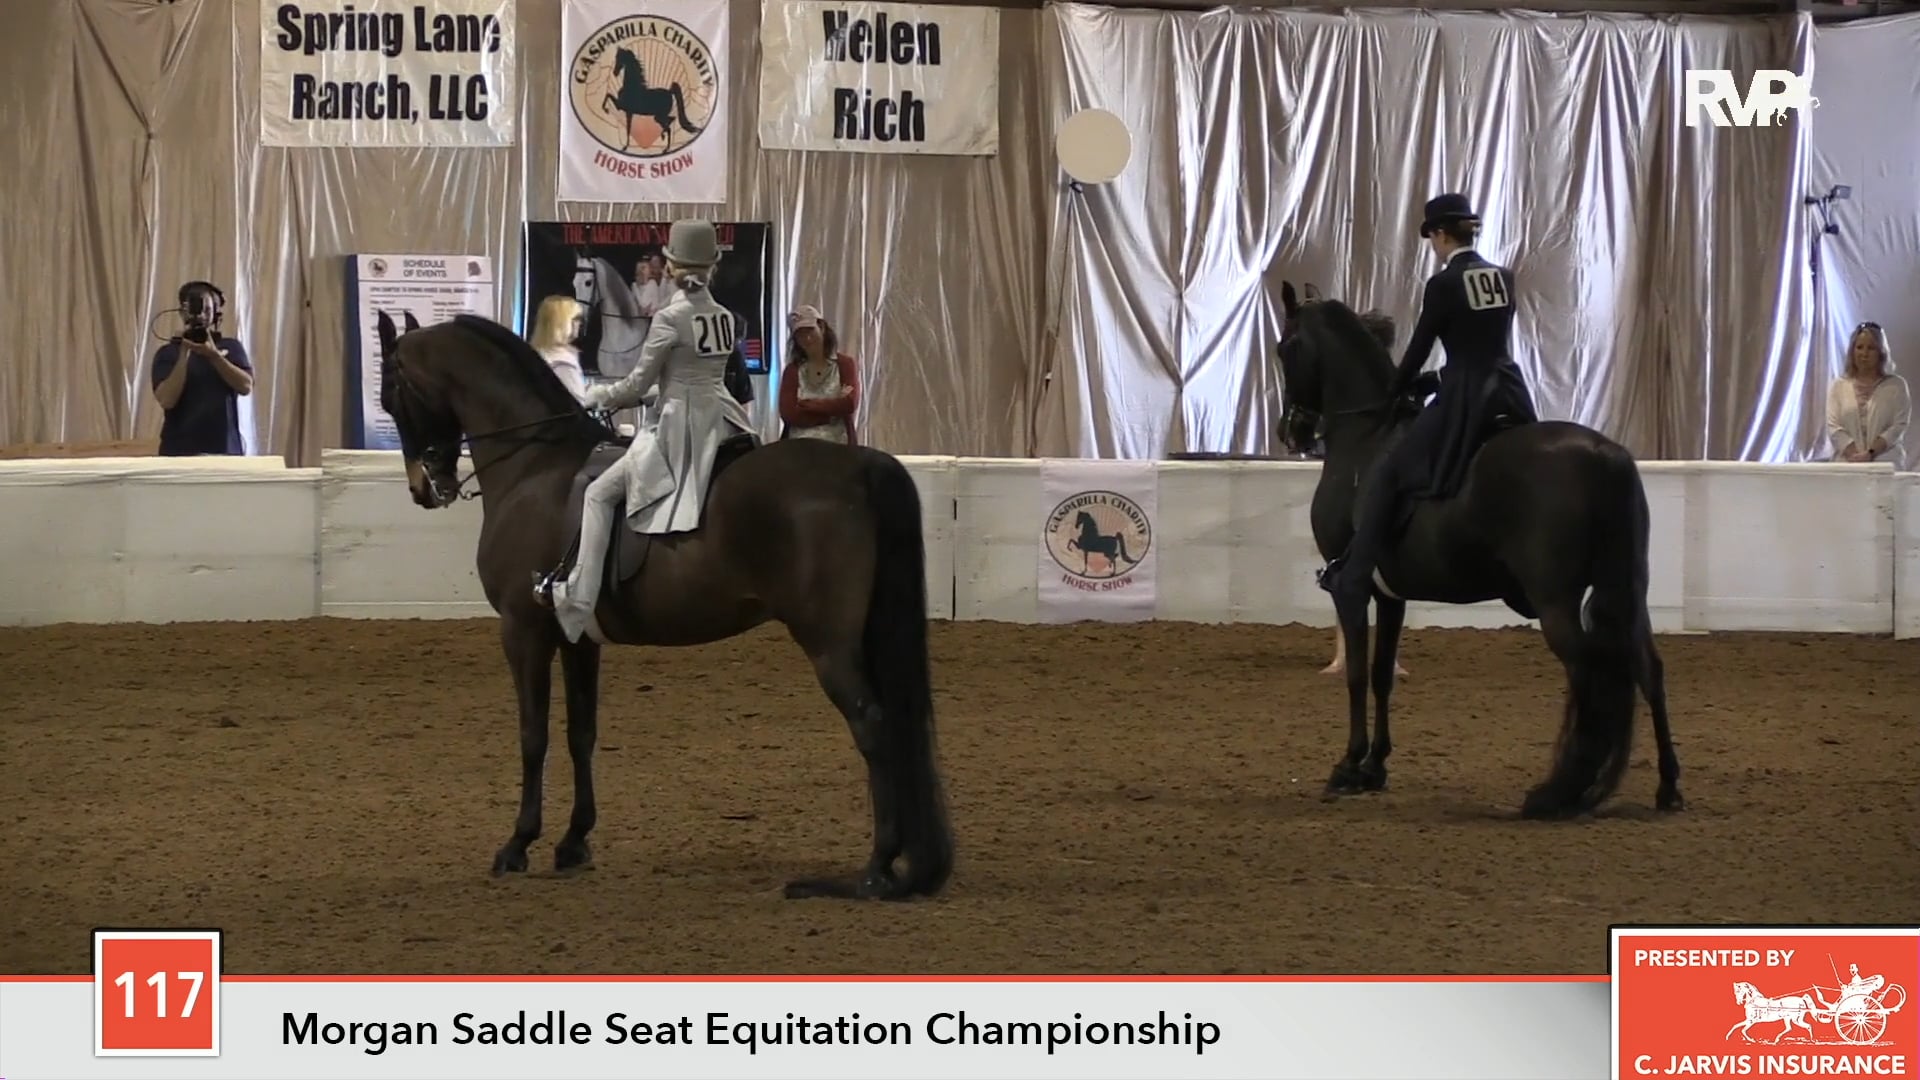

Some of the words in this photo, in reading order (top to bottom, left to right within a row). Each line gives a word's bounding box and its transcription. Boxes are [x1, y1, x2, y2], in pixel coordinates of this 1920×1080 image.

[277, 4, 404, 57] Spring
[414, 6, 501, 53] Lane
[822, 10, 941, 66] Helen
[574, 20, 658, 84] GASPARILLA
[663, 26, 714, 87] CHARITY
[292, 73, 418, 124] Ranch,
[428, 74, 488, 120] LLC
[833, 87, 926, 142] Rich
[594, 150, 646, 179] HORSE
[650, 151, 694, 178] SHOW
[563, 224, 586, 245] THE
[591, 223, 650, 245] AMERICAN
[403, 259, 446, 268] SCHEDULE
[403, 269, 414, 277] OF
[416, 269, 447, 278] EVENTS
[1468, 271, 1506, 307] 194
[694, 313, 733, 353] 210
[1050, 495, 1107, 533] GASPARILLA
[1111, 497, 1147, 535] CHARITY
[1062, 574, 1099, 592] HORSE
[1102, 577, 1132, 592] SHOW
